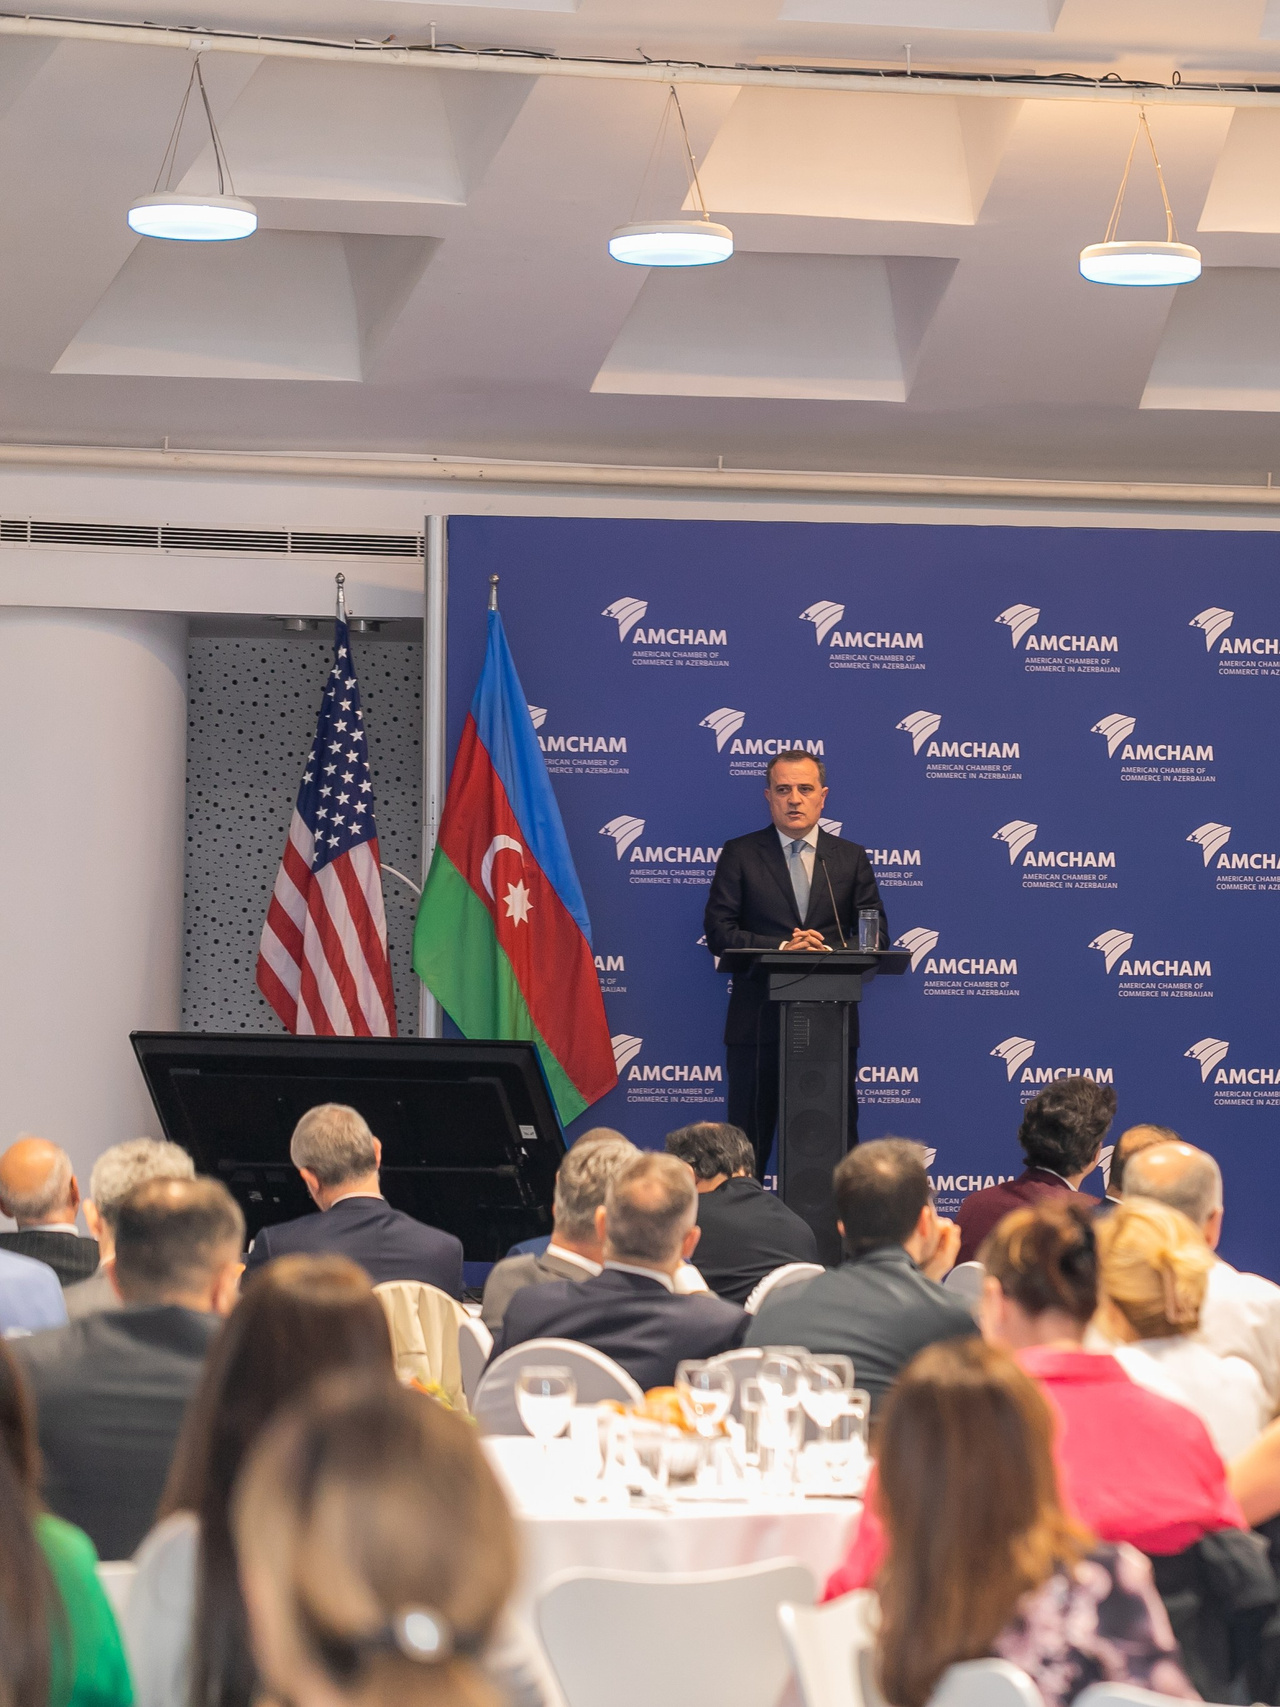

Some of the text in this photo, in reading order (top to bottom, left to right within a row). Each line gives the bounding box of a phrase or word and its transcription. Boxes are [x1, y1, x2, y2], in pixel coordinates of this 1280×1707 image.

[632, 629, 727, 645] AMCHAM
[829, 631, 923, 648] AMCHAM
[1025, 634, 1118, 651] AMCHAM
[633, 650, 719, 659] AMERICAN CHAMBER OF
[830, 653, 915, 662] AMERICAN CHAMBER OF
[632, 658, 673, 666] COMMERCE
[685, 659, 729, 667] AZERBAIJAN
[1064, 657, 1099, 665] CHAMBER
[829, 661, 925, 670] COMMERCE IN AZERBAIJAN
[1025, 665, 1120, 673] COMMERCE IN AZERBAIJAN
[1219, 668, 1259, 676] COMMERCE
[1261, 668, 1268, 676] IN
[730, 739, 824, 755] AMCHAM
[926, 742, 1019, 758] AMCHAM
[1121, 745, 1213, 760] AMCHAM
[544, 758, 570, 766] ERICAN
[572, 758, 607, 766] CHAMBER
[548, 766, 573, 774] MERCE
[585, 767, 629, 775] AZERBAIJAN
[927, 763, 1012, 772] AMERICAN CHAMBER OF
[1121, 766, 1158, 774] AMERICAN
[1196, 767, 1205, 775] OF
[730, 769, 767, 777] COMMERC
[926, 771, 967, 779] COMMERCE
[979, 772, 1022, 780] AZERBAIJAN
[1121, 774, 1161, 782] COMMERCE
[1173, 775, 1215, 783] AZERBAIJAN
[1023, 850, 1115, 867] AMCHAM
[630, 868, 668, 876] AMERICAN
[670, 869, 705, 877] CHAMBER
[874, 871, 913, 879] AMBER OF
[673, 877, 681, 885] IN
[683, 877, 712, 885] AZERBA
[1023, 873, 1107, 881] AMERICAN CHAMBER OF
[1216, 875, 1253, 883] AMERICAN
[880, 879, 923, 887] AZERBAIJAN
[1022, 881, 1117, 889] COMMERCE IN AZERBAIJAN
[1216, 883, 1256, 891] COMMERCE
[1259, 883, 1266, 891] IN
[924, 958, 1017, 974] AMCHAM
[1119, 960, 1211, 976] AMCHAM
[924, 980, 961, 988] AMERICAN
[963, 980, 998, 988] CHAMBER
[1158, 982, 1192, 990] CHAMBER
[1194, 982, 1203, 990] OF
[924, 988, 964, 996] COMMERCE
[1118, 990, 1213, 998] COMMERCE IN AZERBAIJAN
[628, 1065, 722, 1081] AMCHAM
[857, 1067, 919, 1082] CHAM
[627, 1087, 714, 1095] AMERICAN CHAMBER OF
[865, 1088, 899, 1096] CHAMBER
[901, 1088, 911, 1096] OF
[1214, 1090, 1251, 1098] AMERICAN
[627, 1095, 668, 1103] COMMERCE
[680, 1095, 724, 1103] AZERBAIJAN
[877, 1096, 921, 1104] AZERBAIJAN
[1214, 1098, 1254, 1106] COMMERCE
[1256, 1098, 1264, 1106] IN
[926, 1175, 1015, 1191] AMCHA
